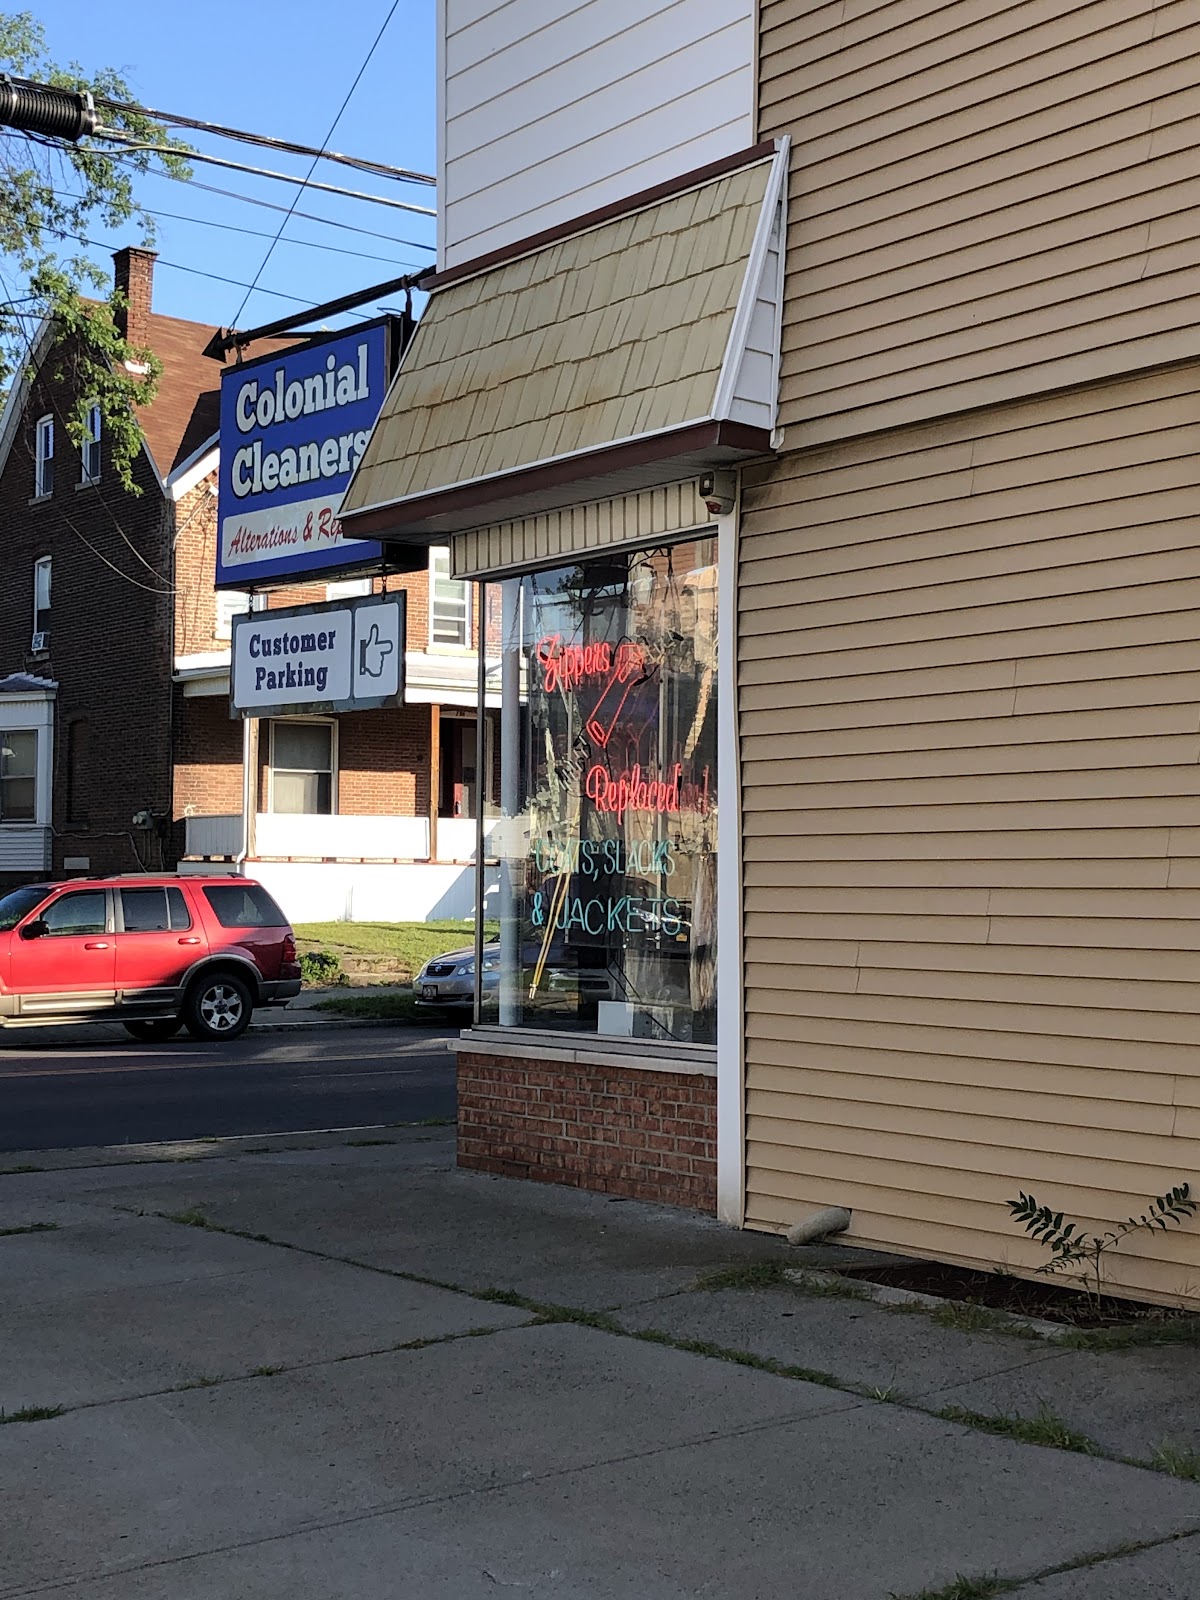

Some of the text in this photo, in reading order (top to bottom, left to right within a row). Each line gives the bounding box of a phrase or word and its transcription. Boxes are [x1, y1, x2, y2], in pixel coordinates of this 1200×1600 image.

[235, 343, 369, 433] Colonial
[228, 524, 299, 558] Alterations
[302, 512, 313, 542] &
[249, 629, 337, 659] Customer
[537, 634, 612, 693] Zippers
[254, 662, 329, 692] Parking
[586, 763, 681, 825] Replaced
[604, 839, 676, 877] SLACKS
[531, 892, 682, 936] & JACKETS
